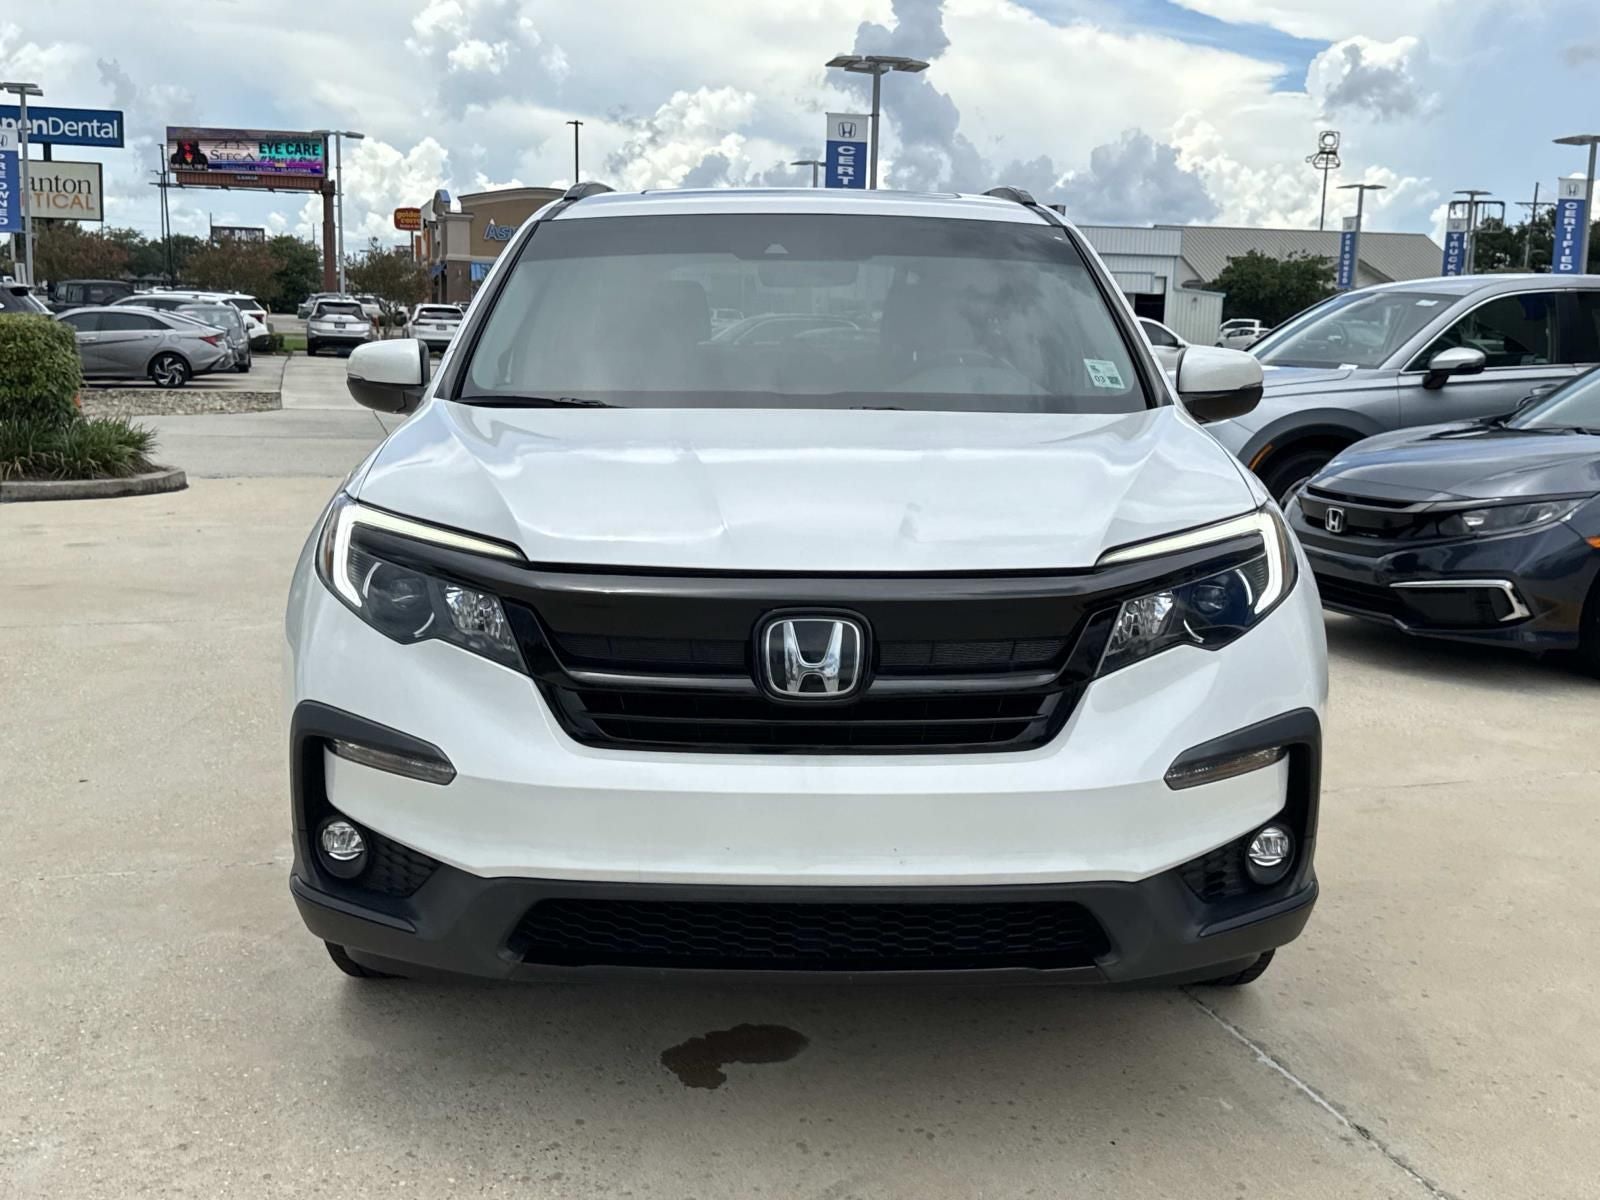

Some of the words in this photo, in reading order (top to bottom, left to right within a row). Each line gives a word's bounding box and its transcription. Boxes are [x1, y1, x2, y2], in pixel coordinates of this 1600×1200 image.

[0, 116, 118, 139] penDental
[259, 142, 283, 155] EYE
[285, 143, 320, 157] CARE
[837, 145, 856, 188] CERT
[1560, 202, 1578, 271] CERTIFIED
